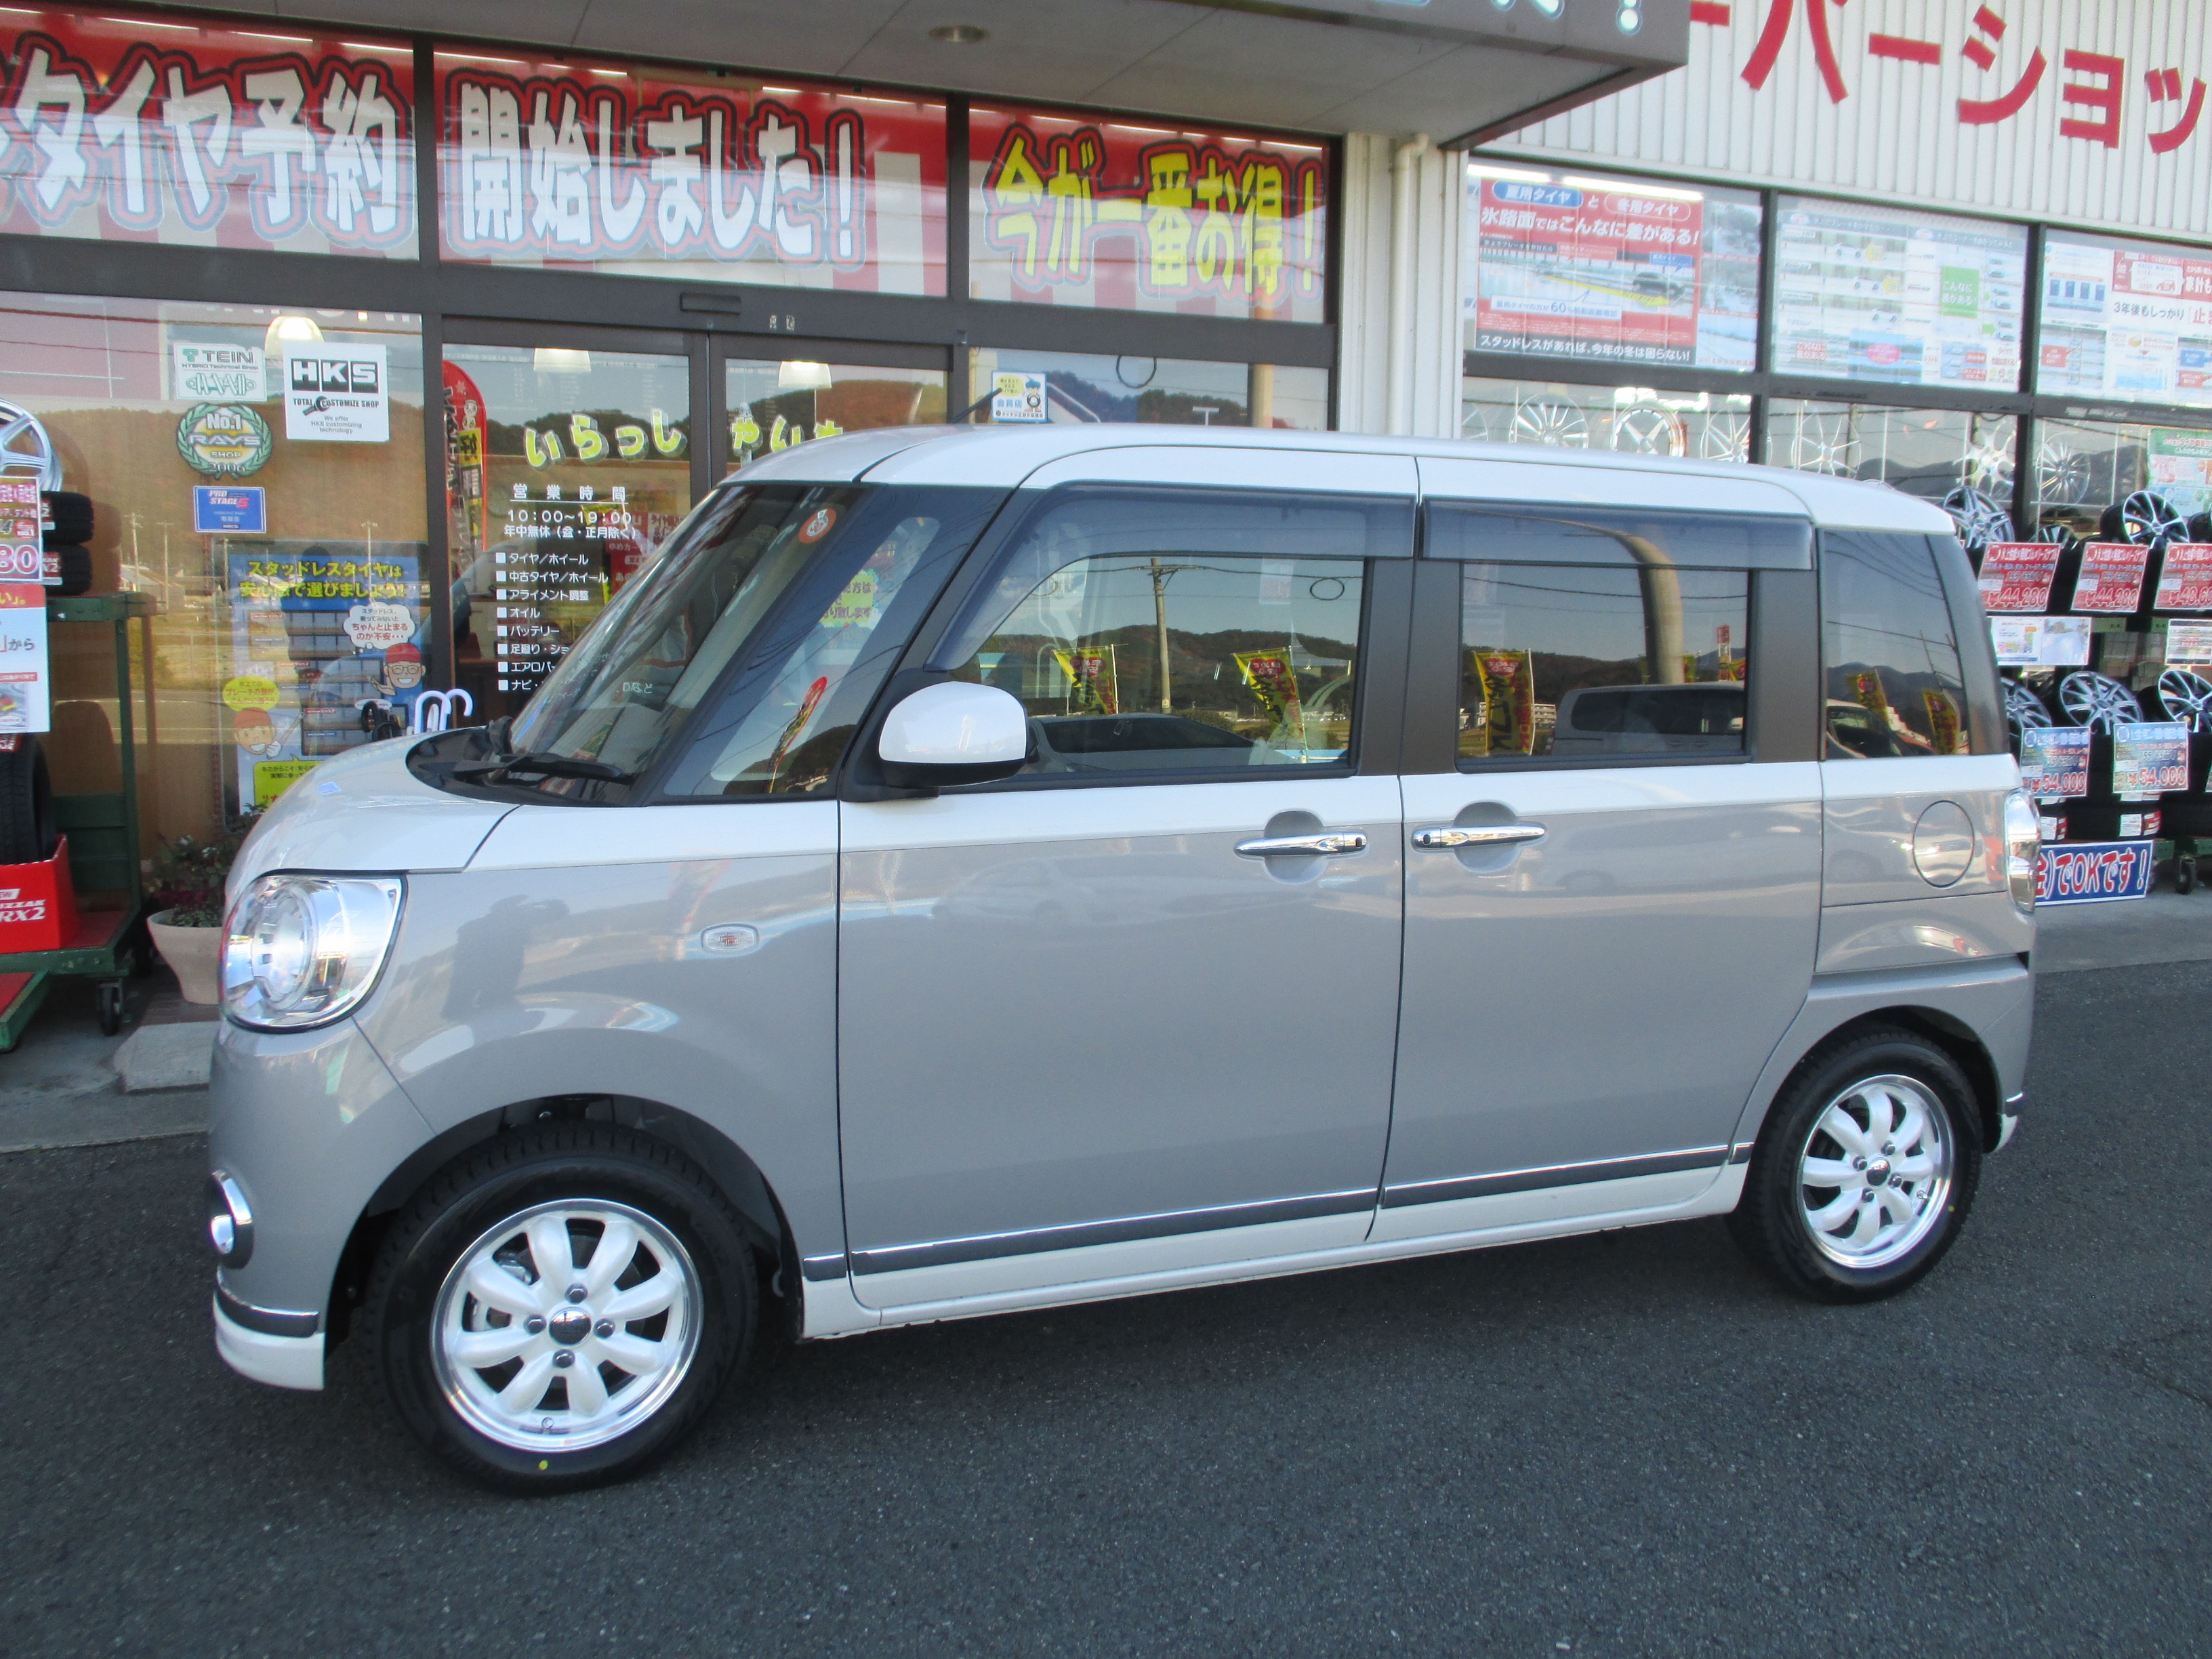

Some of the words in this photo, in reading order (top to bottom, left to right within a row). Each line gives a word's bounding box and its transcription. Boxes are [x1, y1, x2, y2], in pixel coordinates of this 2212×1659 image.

[0, 49, 397, 234] タイヤ予約
[462, 82, 852, 258] 開始しました!
[201, 350, 253, 363] TEIN
[291, 359, 378, 389] HKS
[322, 398, 359, 407] CUSTOMIZE
[206, 414, 241, 430] No.1
[188, 434, 262, 446] RAYS
[525, 409, 681, 468] いらっし
[209, 462, 246, 473] 2006
[513, 483, 626, 501] 営業時間
[247, 560, 402, 578] スタッドレスタイヤは
[510, 589, 590, 602] アライメント調整
[510, 607, 541, 619] オイル
[351, 623, 408, 632] ちゃんと止まる
[510, 625, 560, 638] バッテリー
[511, 680, 545, 690] ナビ・
